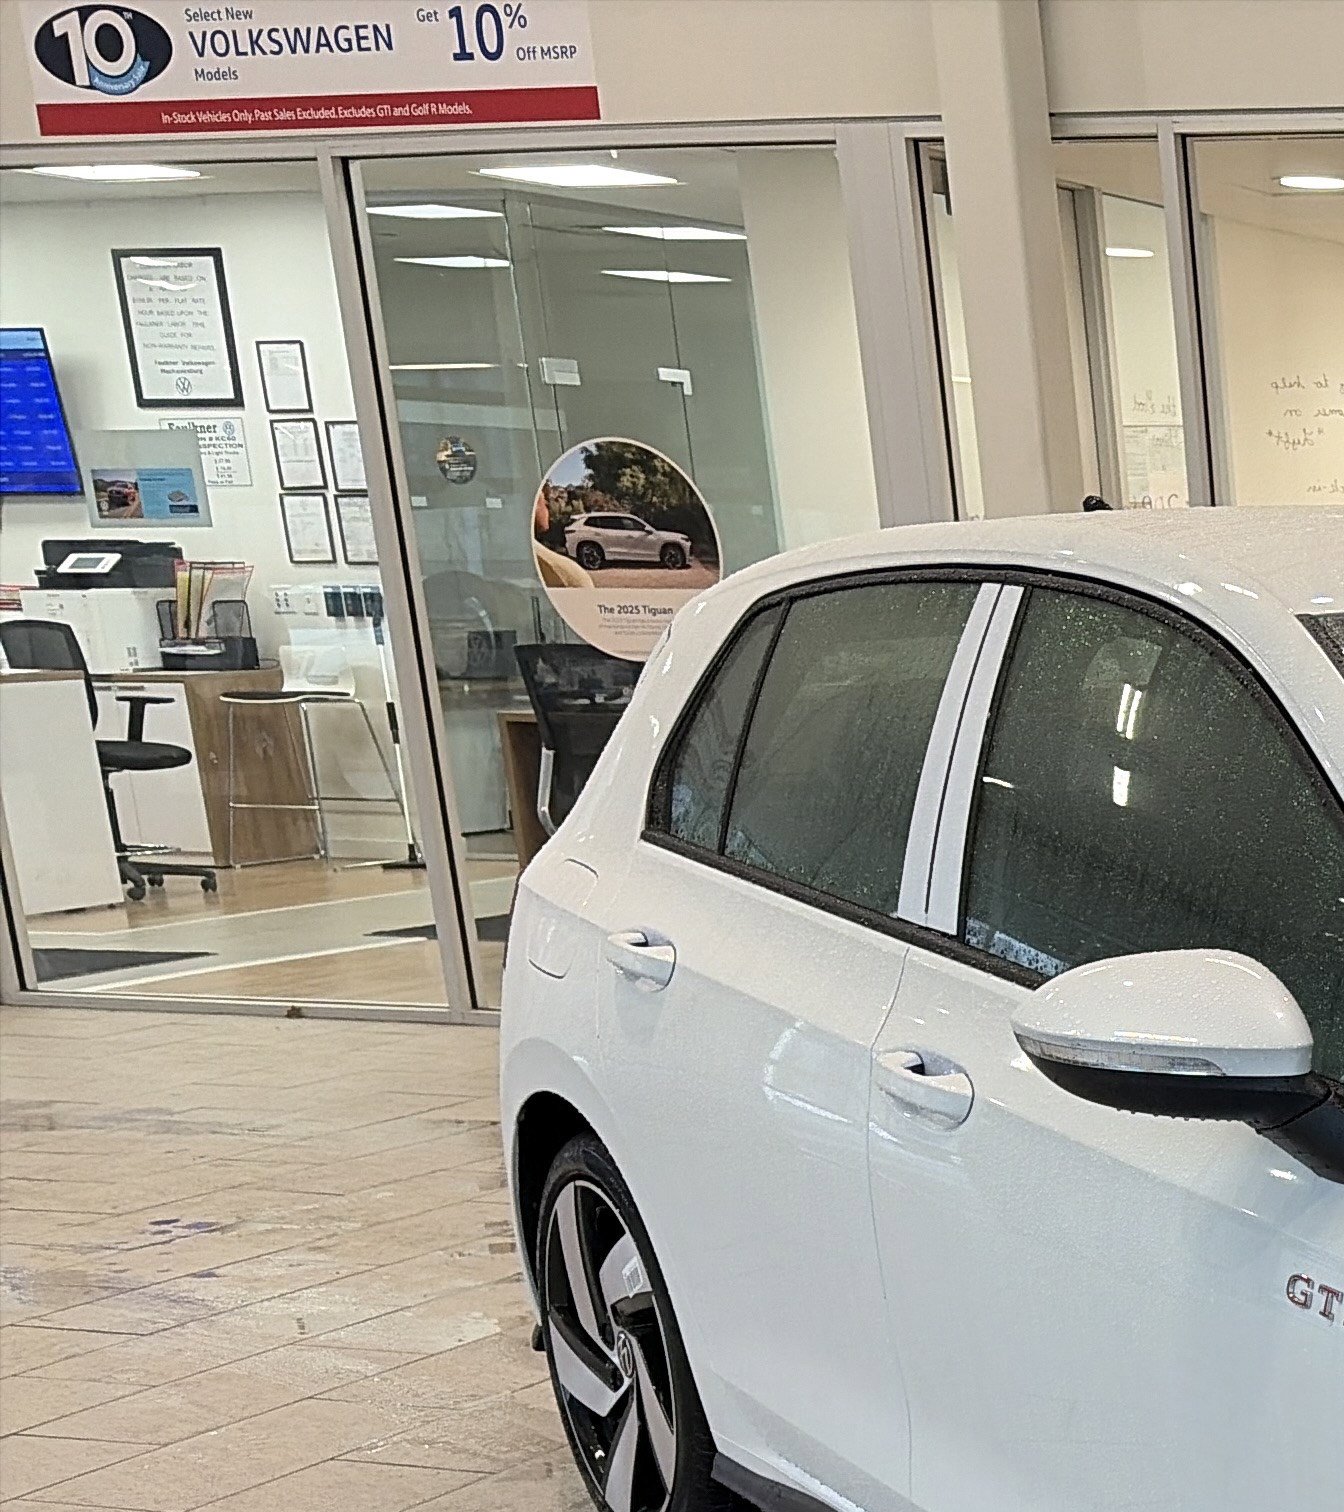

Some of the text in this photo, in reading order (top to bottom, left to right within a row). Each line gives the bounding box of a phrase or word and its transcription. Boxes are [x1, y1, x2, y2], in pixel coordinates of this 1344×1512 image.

[184, 7, 254, 22] Select New
[416, 8, 439, 22] Get
[188, 23, 394, 58] VOLKSWAGEN
[516, 45, 577, 61] Off MSRP
[194, 67, 239, 82] Models
[161, 111, 196, 124] In-Stock
[196, 110, 232, 123] Vehicles
[254, 108, 273, 121] Past
[274, 107, 296, 121] Sales
[296, 106, 338, 120] Excluded.
[338, 105, 376, 118] Excludes
[377, 104, 392, 117] GTI
[393, 104, 410, 117] and
[411, 103, 430, 116] Golf
[431, 103, 438, 115] R
[438, 101, 473, 115] Models.
[597, 604, 674, 617] The 2025 Tiguan
